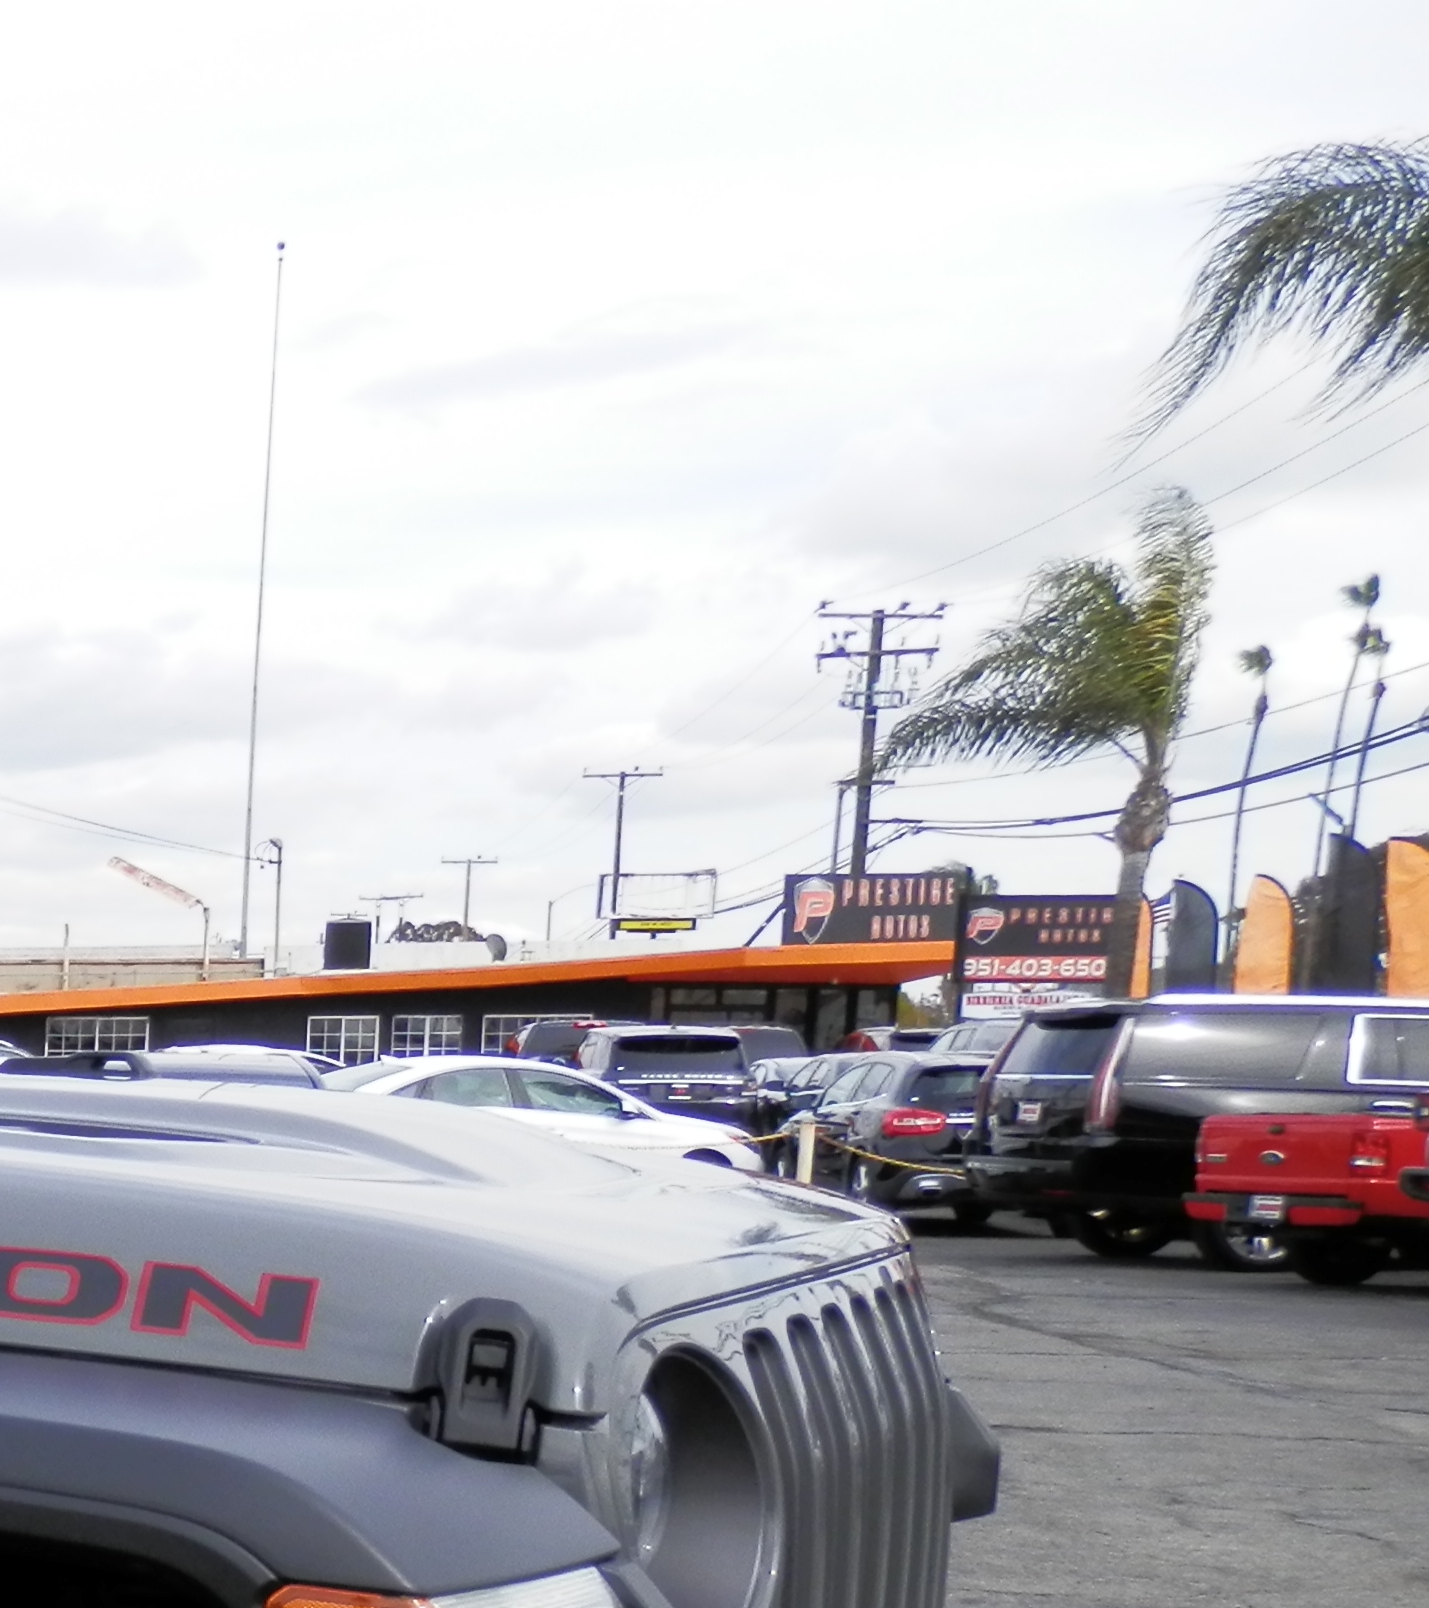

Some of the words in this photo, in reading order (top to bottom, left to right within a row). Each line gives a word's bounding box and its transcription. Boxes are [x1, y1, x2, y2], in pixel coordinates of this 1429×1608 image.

[841, 876, 956, 908] PRESTIGE
[870, 914, 931, 940] AUTOS
[1008, 906, 1115, 925] PRESTIG
[963, 957, 1108, 978] 951-403-650
